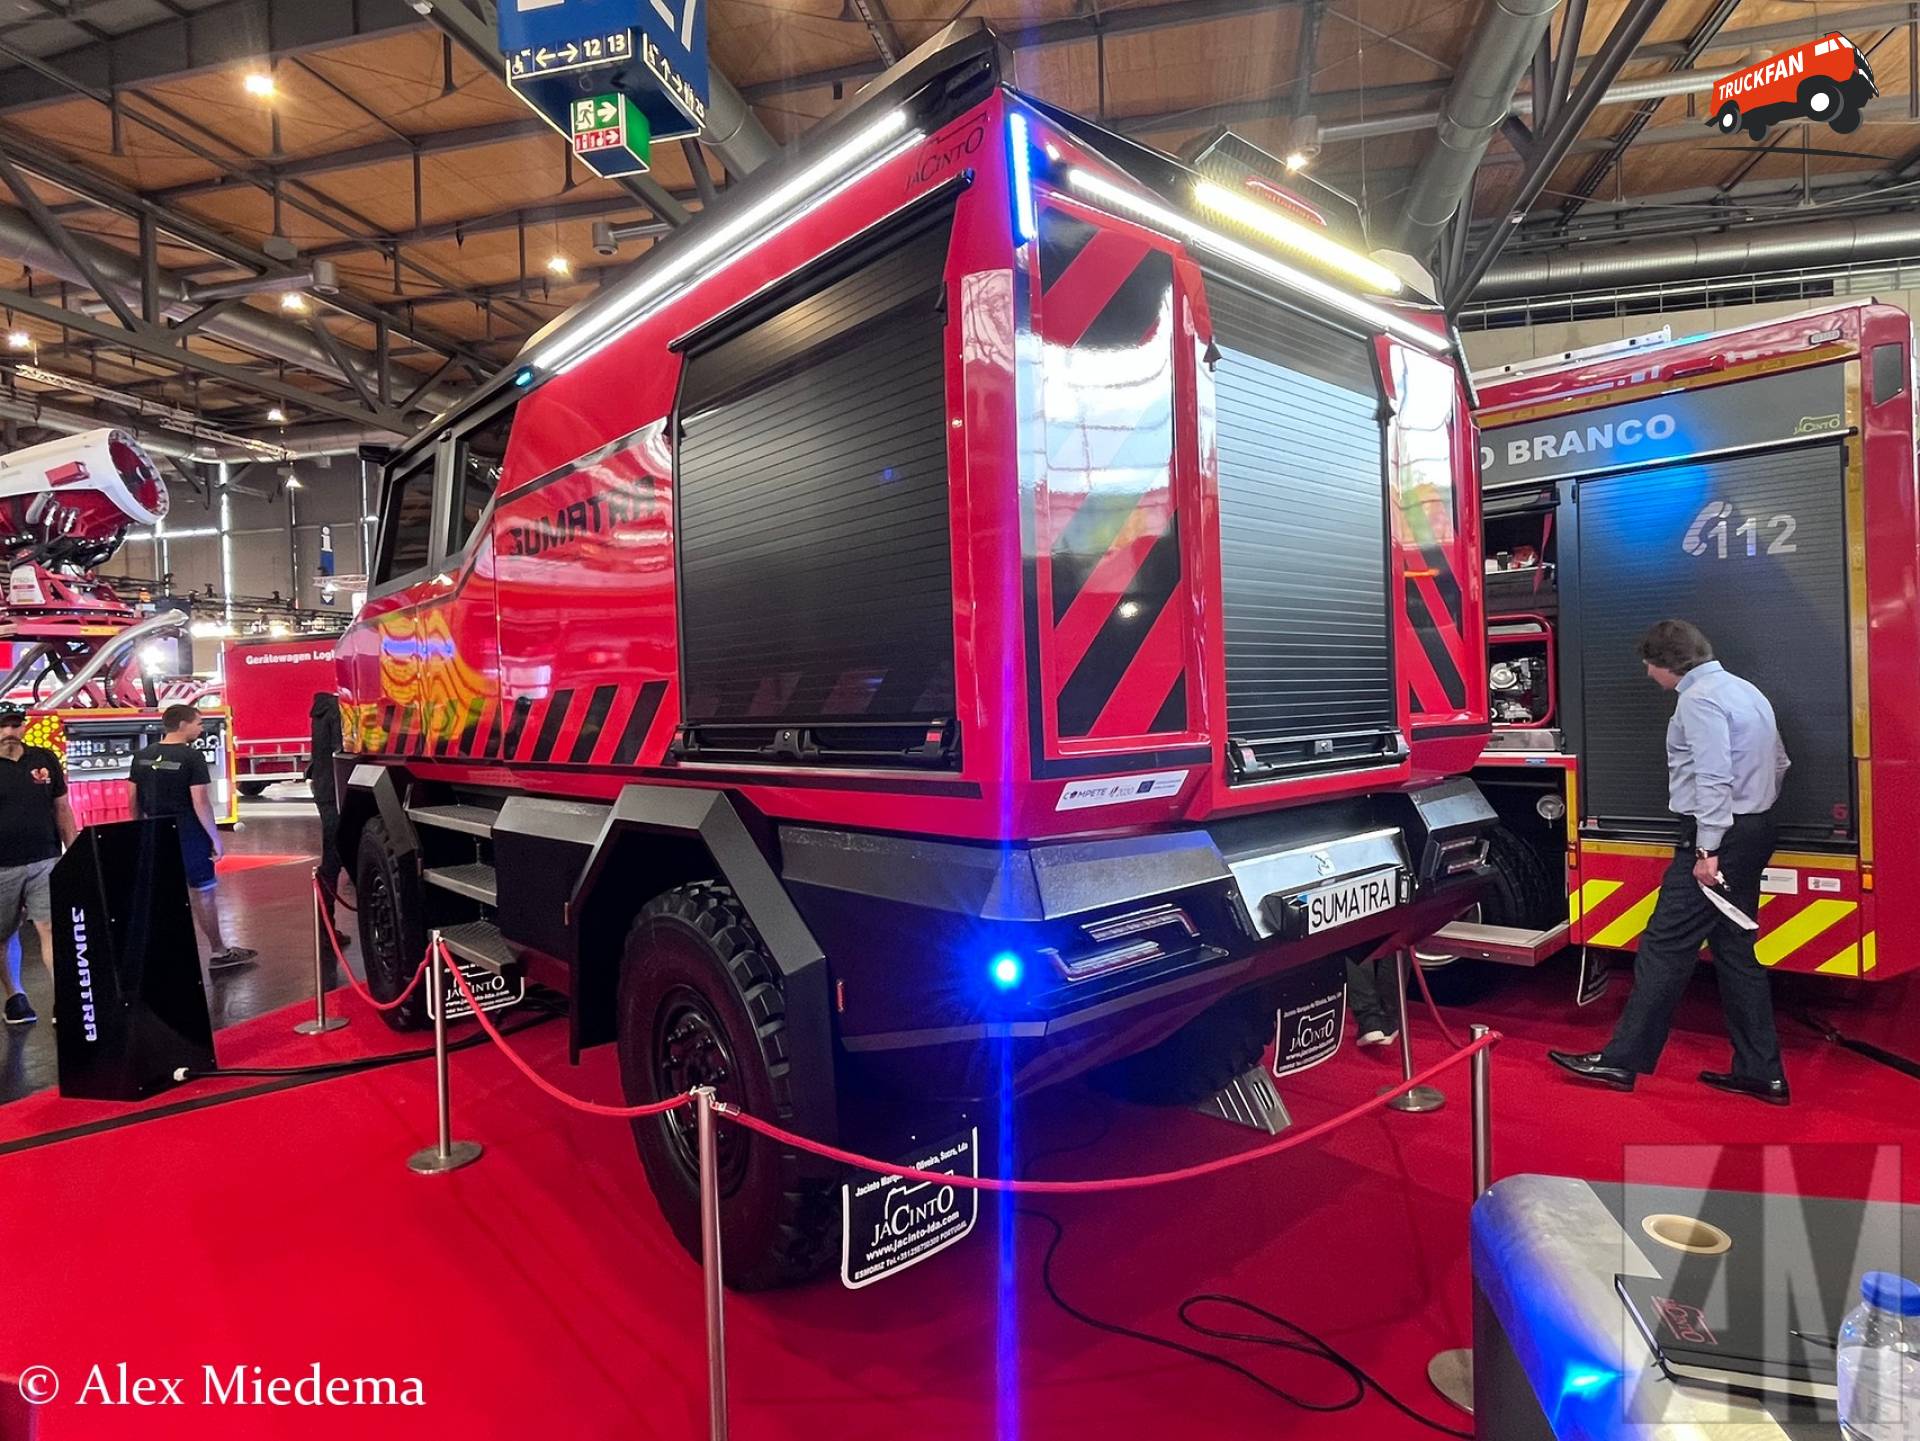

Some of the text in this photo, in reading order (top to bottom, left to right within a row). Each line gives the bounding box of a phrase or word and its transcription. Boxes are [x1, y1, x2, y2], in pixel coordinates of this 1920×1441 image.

[583, 34, 625, 57] 12 13
[1507, 414, 1676, 465] BRANCO
[508, 474, 656, 557] SUMATRA
[1707, 513, 1797, 559] 112
[245, 652, 311, 665] Gerätewagen
[1311, 878, 1391, 929] SUMATRA
[71, 906, 98, 1042] SUMATRA
[1289, 1018, 1335, 1053] JACINTO
[865, 1210, 960, 1262] www.jacinto-lda.com
[871, 1185, 954, 1247] JACINTO
